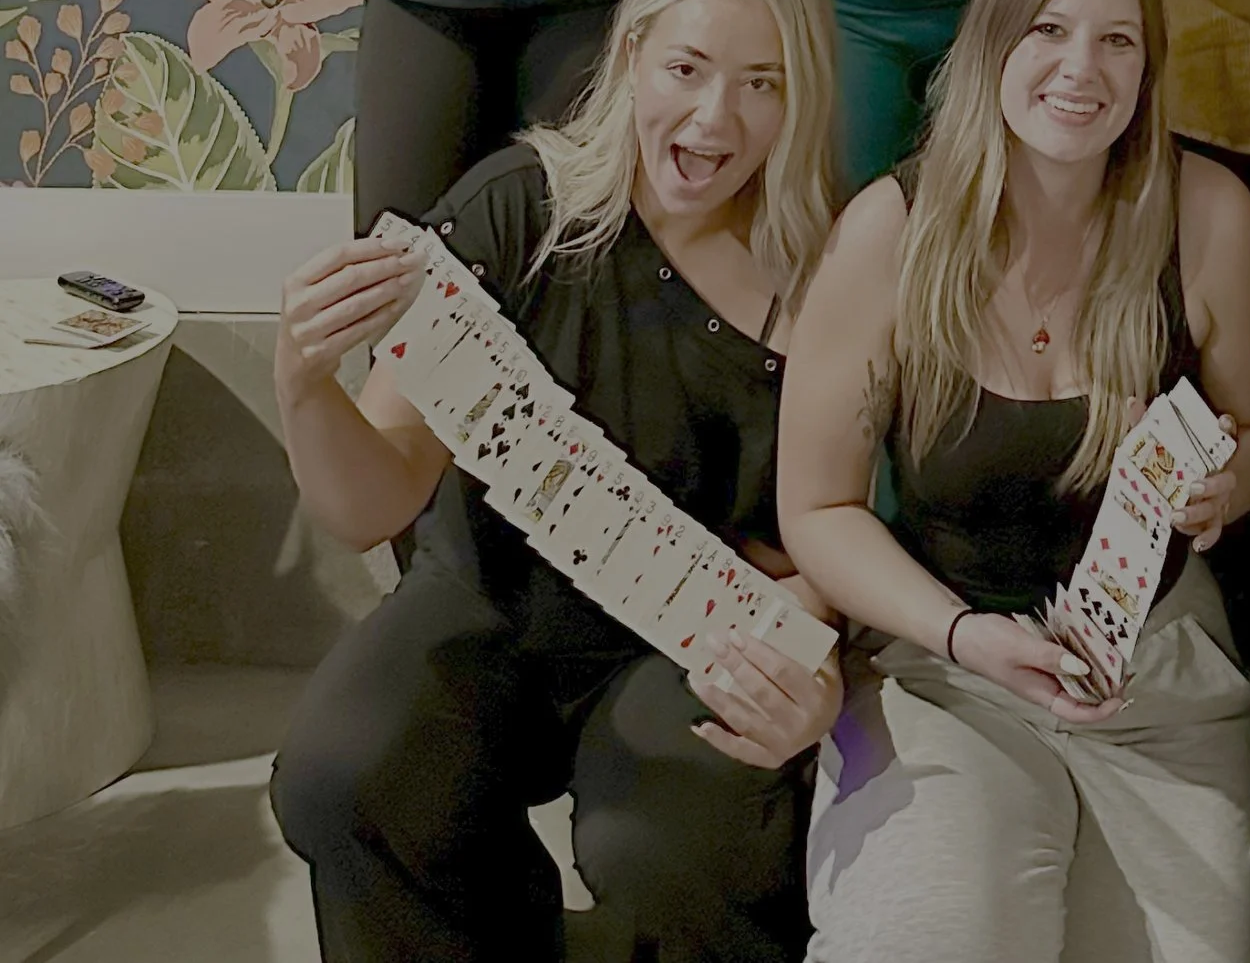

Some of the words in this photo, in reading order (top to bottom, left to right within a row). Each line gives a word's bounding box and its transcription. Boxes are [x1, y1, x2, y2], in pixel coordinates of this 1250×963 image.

[433, 255, 446, 268] 2
[456, 296, 468, 309] 7
[498, 341, 510, 354] 5
[508, 368, 528, 383] 10
[555, 415, 565, 427] 8
[614, 472, 625, 485] 5
[646, 500, 657, 514] 3
[661, 513, 672, 526] 9
[675, 525, 686, 538] 2
[707, 549, 719, 562] A
[722, 558, 734, 570] 8
